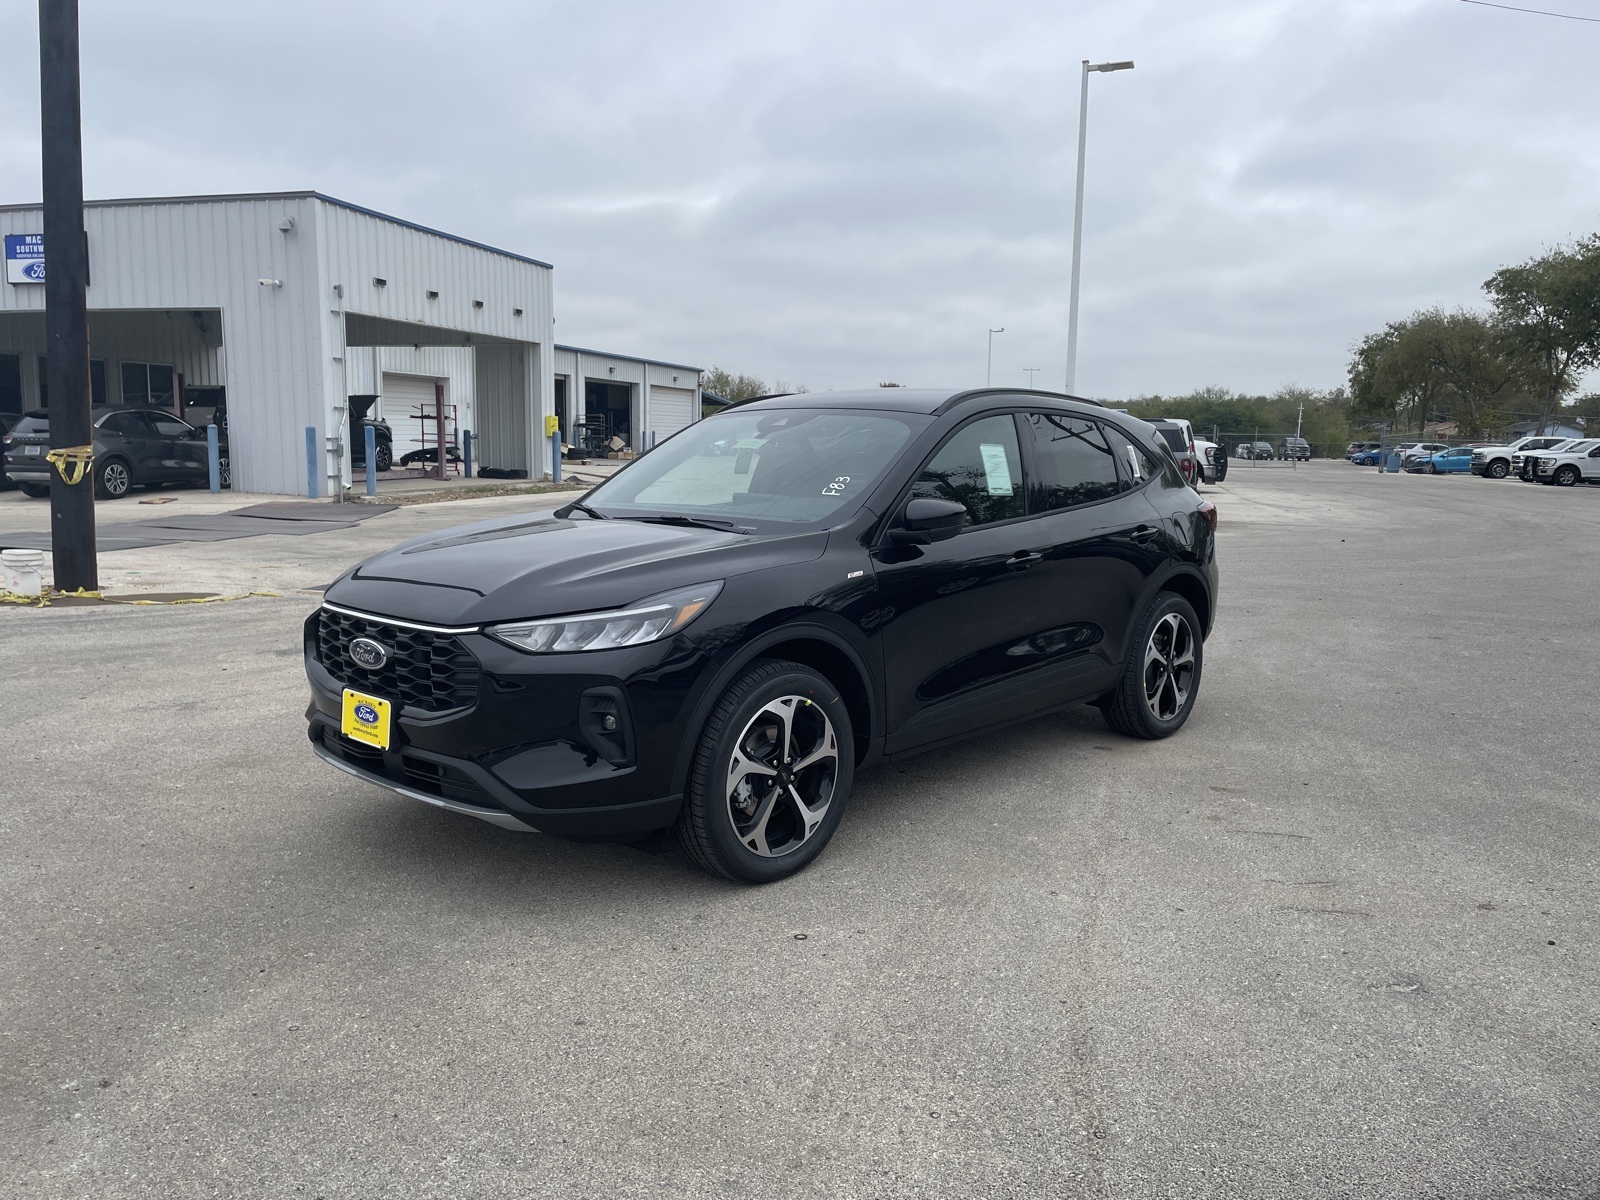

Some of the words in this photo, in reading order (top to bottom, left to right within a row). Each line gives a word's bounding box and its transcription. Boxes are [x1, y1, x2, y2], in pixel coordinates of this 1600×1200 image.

[26, 236, 42, 244] MAC
[822, 476, 850, 496] F83
[355, 644, 375, 664] Ford
[358, 706, 374, 722] Ford
